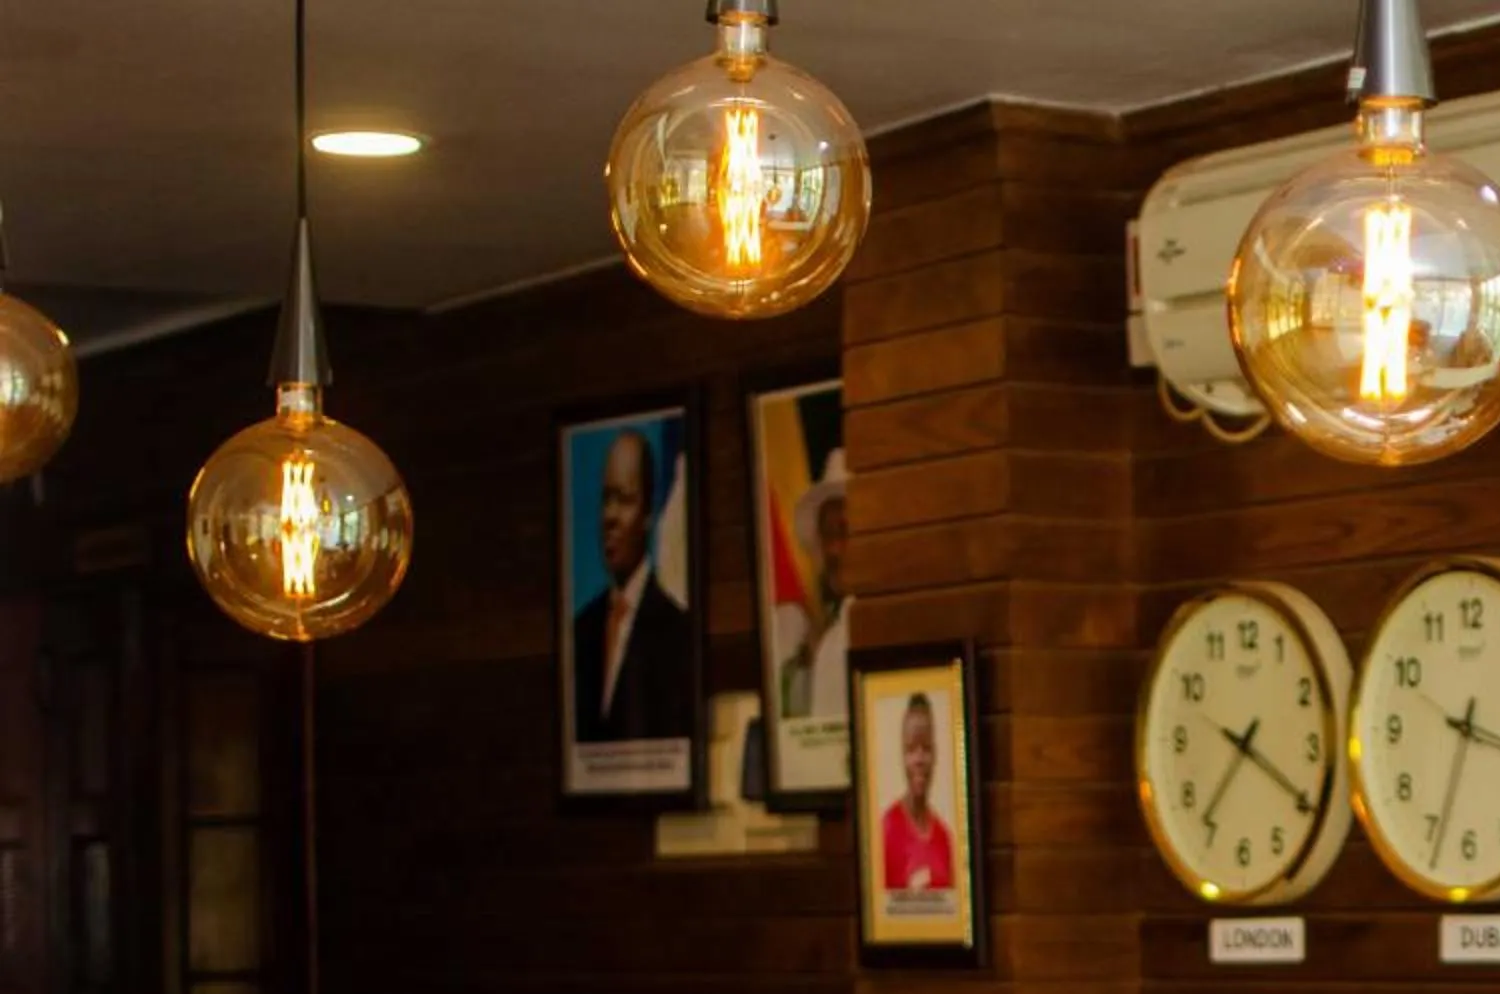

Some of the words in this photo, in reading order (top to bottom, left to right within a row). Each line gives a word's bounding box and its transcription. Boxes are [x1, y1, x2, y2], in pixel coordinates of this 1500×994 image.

[1423, 611, 1445, 642] 11
[1459, 597, 1484, 630] 12
[1206, 631, 1225, 661] 11
[1237, 620, 1259, 649] 12
[1273, 633, 1284, 664] 1
[1181, 672, 1204, 702] 10
[1394, 656, 1422, 688] 10
[1297, 676, 1311, 708] 2
[1173, 724, 1187, 753] 9
[1386, 714, 1403, 745] 9
[1306, 732, 1320, 763] 3
[1181, 780, 1195, 809] 8
[1397, 772, 1412, 802] 8
[1270, 825, 1284, 856] 5
[1423, 813, 1439, 843] 7
[1236, 837, 1251, 868] 6
[1461, 829, 1477, 861] 6
[1224, 927, 1293, 949] LONDON
